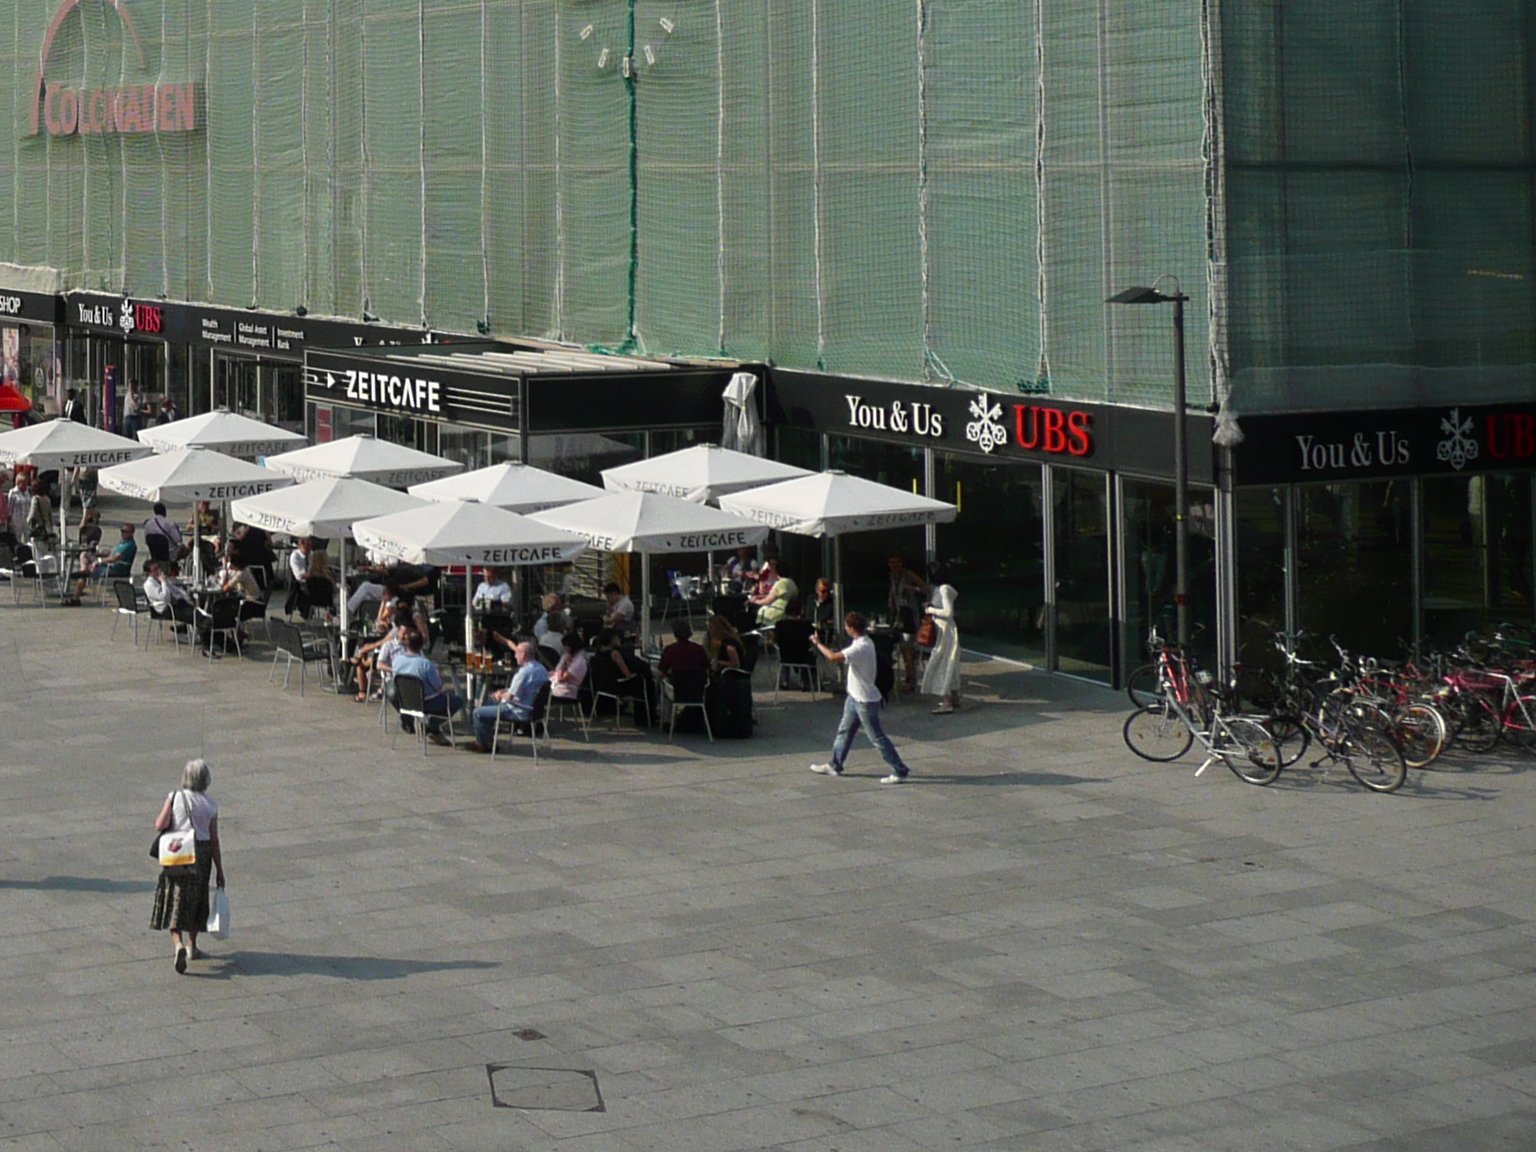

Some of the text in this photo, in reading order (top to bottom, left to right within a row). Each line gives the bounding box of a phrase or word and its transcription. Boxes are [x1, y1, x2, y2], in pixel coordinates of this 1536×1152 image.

[78, 303, 163, 332] You & Us UBS
[346, 370, 441, 412] ZEITCAFE
[845, 394, 1092, 456] You & Us UBS
[73, 451, 132, 465] ZEITCAFE
[1295, 434, 1345, 470] You
[1351, 431, 1373, 467] &
[1377, 430, 1410, 466] Us
[209, 483, 273, 498] ZEITCAFE
[680, 532, 747, 548] ZEITCAFE
[483, 547, 563, 562] ZEITCAFE
